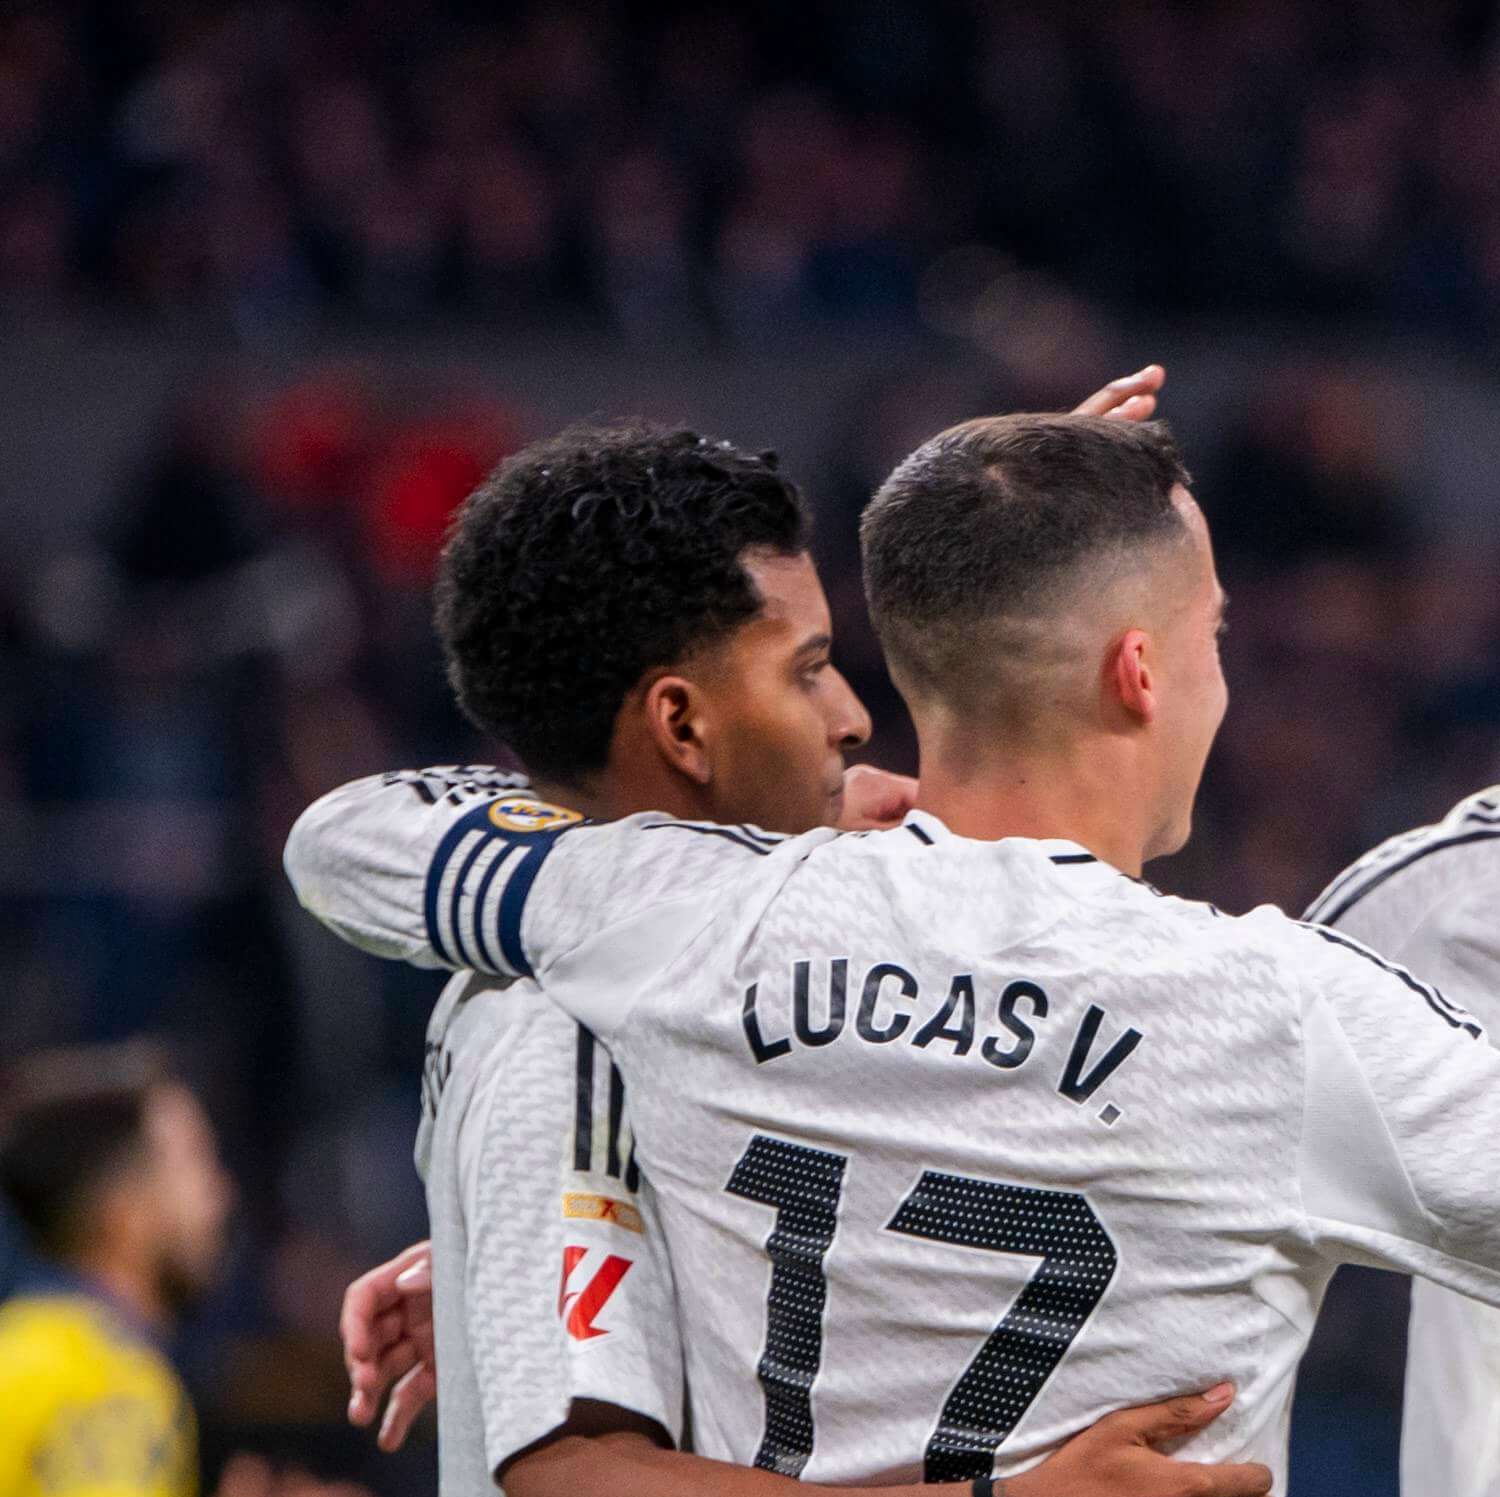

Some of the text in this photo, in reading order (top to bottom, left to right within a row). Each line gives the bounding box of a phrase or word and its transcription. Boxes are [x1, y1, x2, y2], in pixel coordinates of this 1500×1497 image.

[742, 957, 1144, 1128] LUCAS V.
[724, 1133, 1118, 1486] 17
